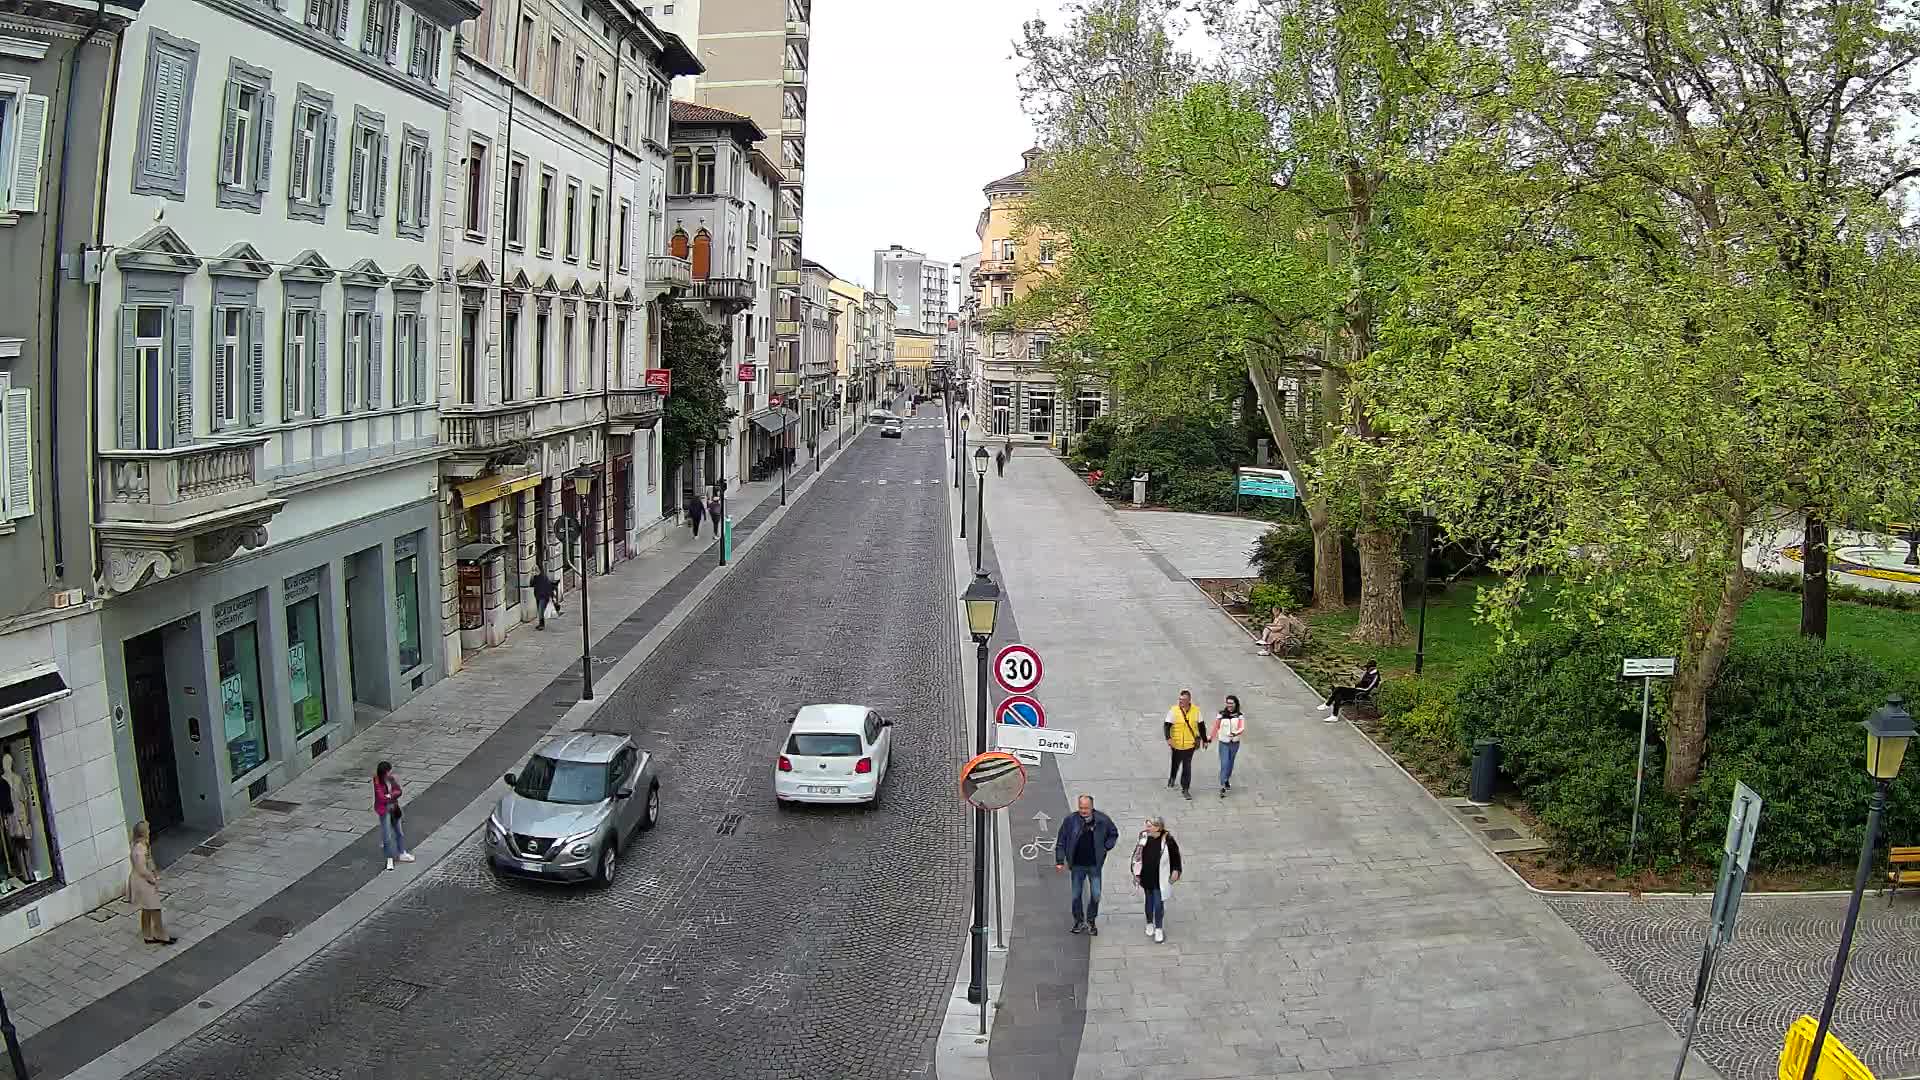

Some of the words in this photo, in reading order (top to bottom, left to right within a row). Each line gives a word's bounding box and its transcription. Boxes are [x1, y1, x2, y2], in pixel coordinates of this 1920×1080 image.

[1005, 658, 1033, 681] 30
[223, 677, 241, 700] 130
[1038, 738, 1070, 750] Dante
